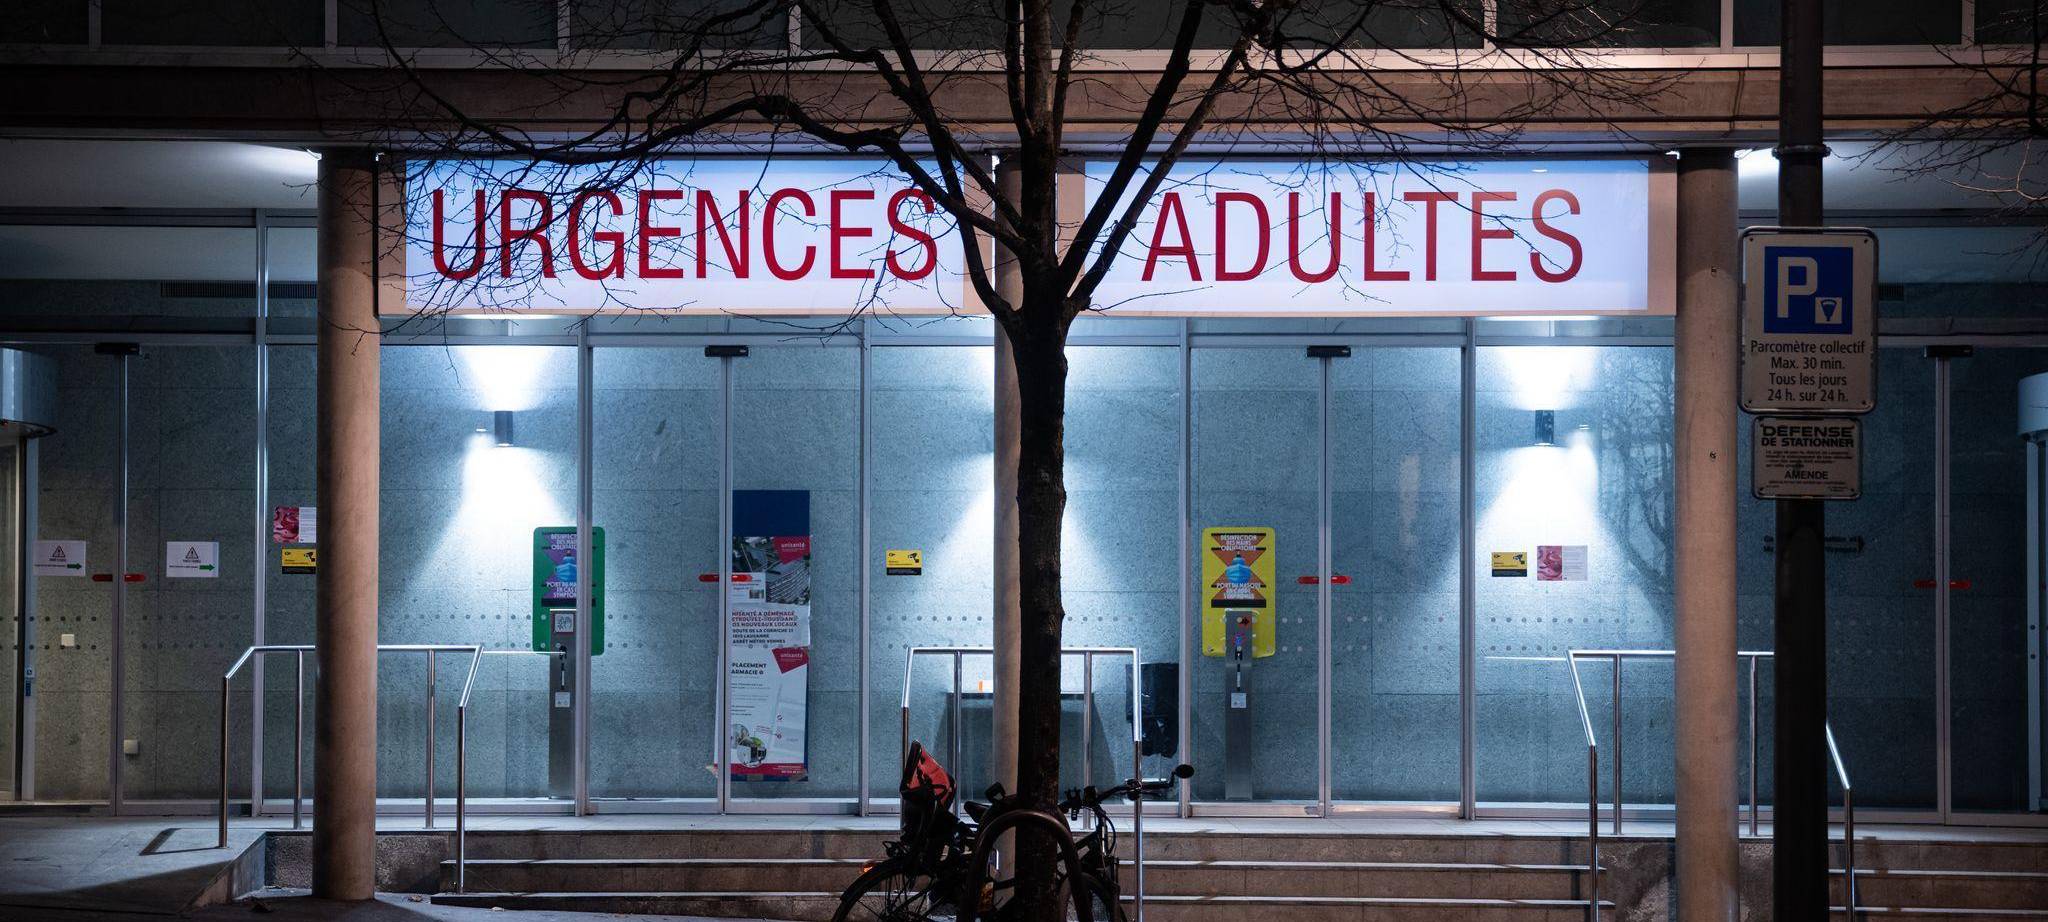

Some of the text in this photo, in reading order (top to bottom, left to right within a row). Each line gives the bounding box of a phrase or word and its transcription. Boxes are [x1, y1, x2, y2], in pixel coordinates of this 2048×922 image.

[432, 187, 1583, 283] URGENCES ADULTES
[1776, 256, 1818, 319] P
[1751, 340, 1866, 354] Parcomètre collectif
[1771, 357, 1845, 369] Max. 30 min.
[1769, 373, 1847, 389] Tous les jours
[1768, 388, 1848, 402] 24 h. sur 24 h.
[1761, 438, 1854, 448] DE STATIONNER
[1785, 470, 1829, 480] AMENDE
